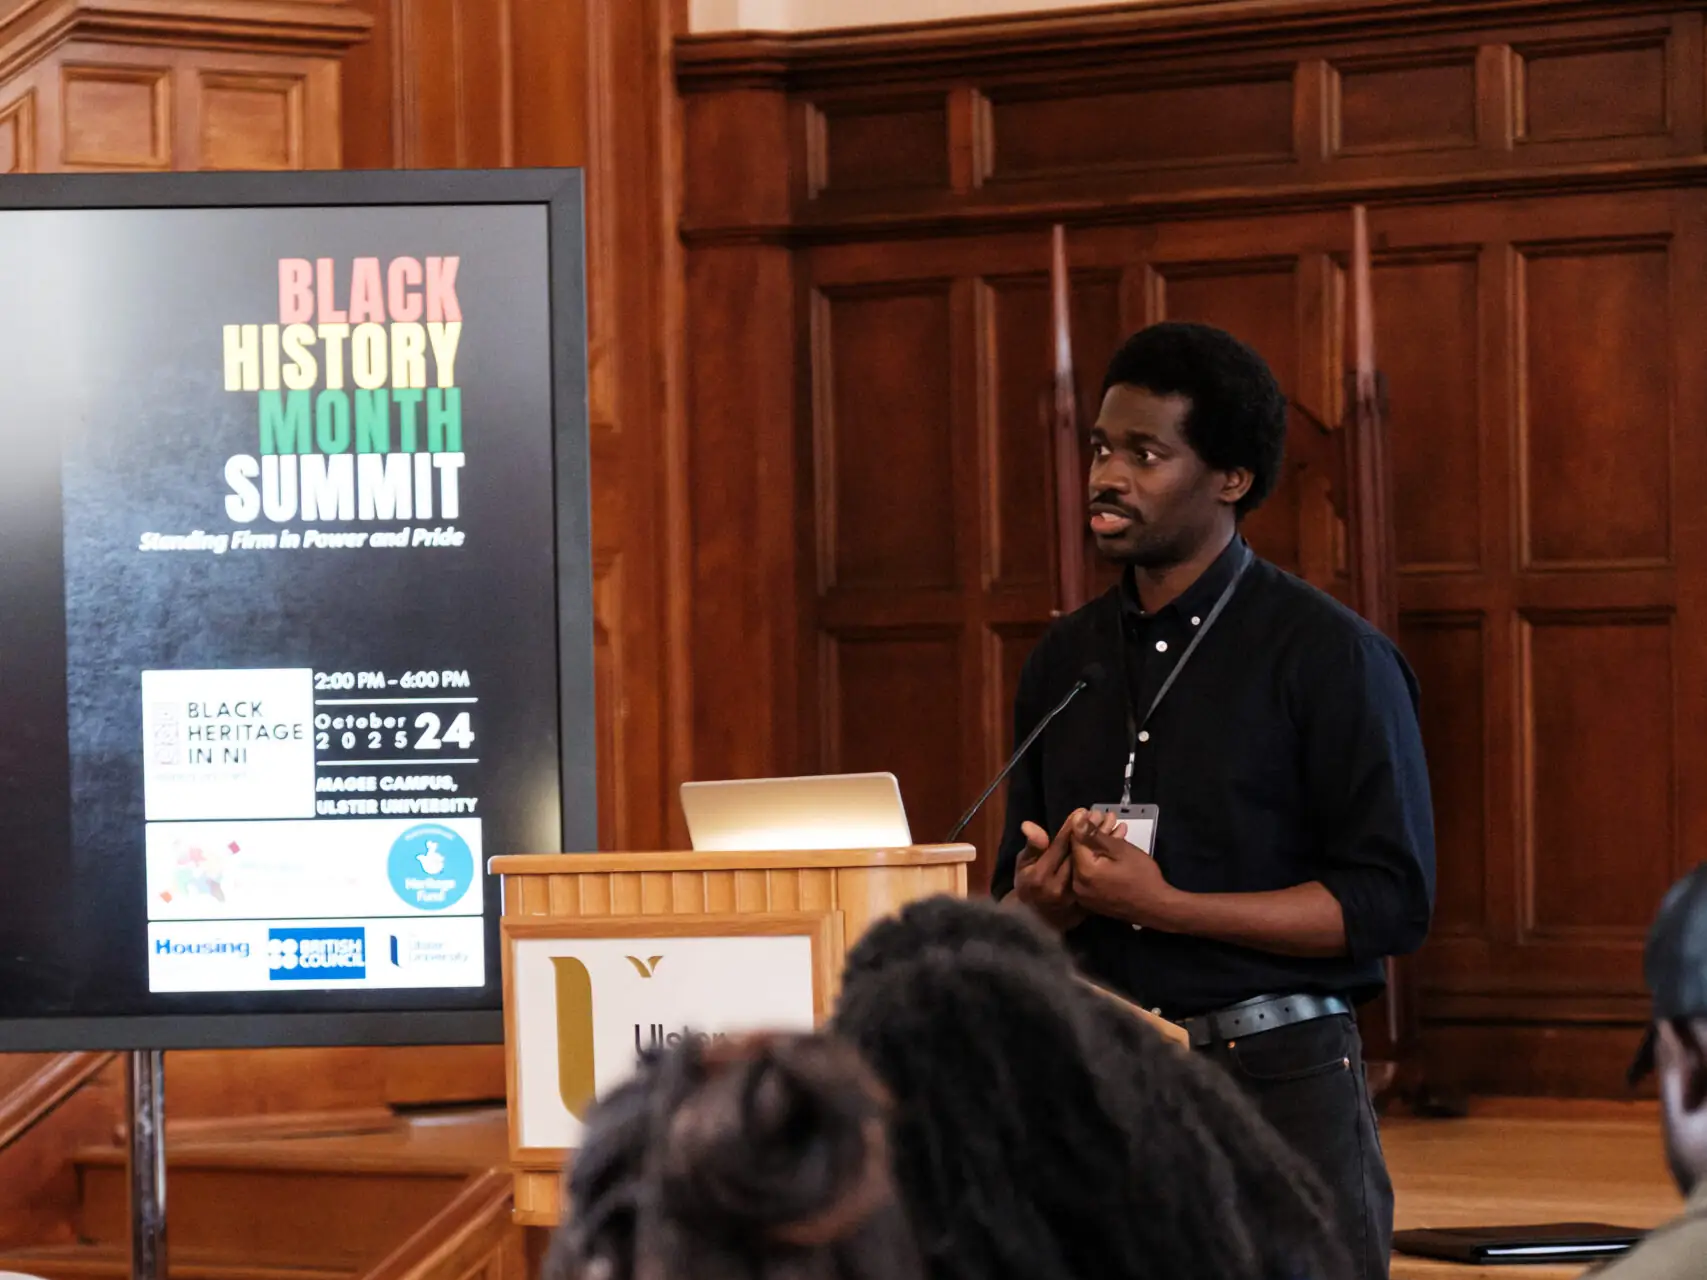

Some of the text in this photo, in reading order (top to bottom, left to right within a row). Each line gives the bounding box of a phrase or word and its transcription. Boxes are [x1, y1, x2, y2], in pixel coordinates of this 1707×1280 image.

[278, 256, 463, 324] BLACK
[223, 322, 462, 391] HISTORY
[259, 387, 462, 455] MONTH
[224, 452, 465, 522] SUMMIT
[139, 526, 466, 554] Standing Firm in Power and Pride
[314, 672, 355, 690] 2:00
[357, 671, 386, 689] PM
[400, 670, 440, 688] 6:00
[441, 670, 470, 687] PM
[188, 702, 264, 718] BLACK
[314, 712, 407, 730] October
[188, 724, 304, 741] HERITAGE
[414, 712, 475, 750] 24
[189, 748, 247, 764] IN NI
[380, 775, 458, 792] CAMPUS,
[316, 797, 478, 814] ULSTER UNIVERSITY
[156, 939, 250, 957] Housing
[300, 953, 365, 968] COUNCIL
